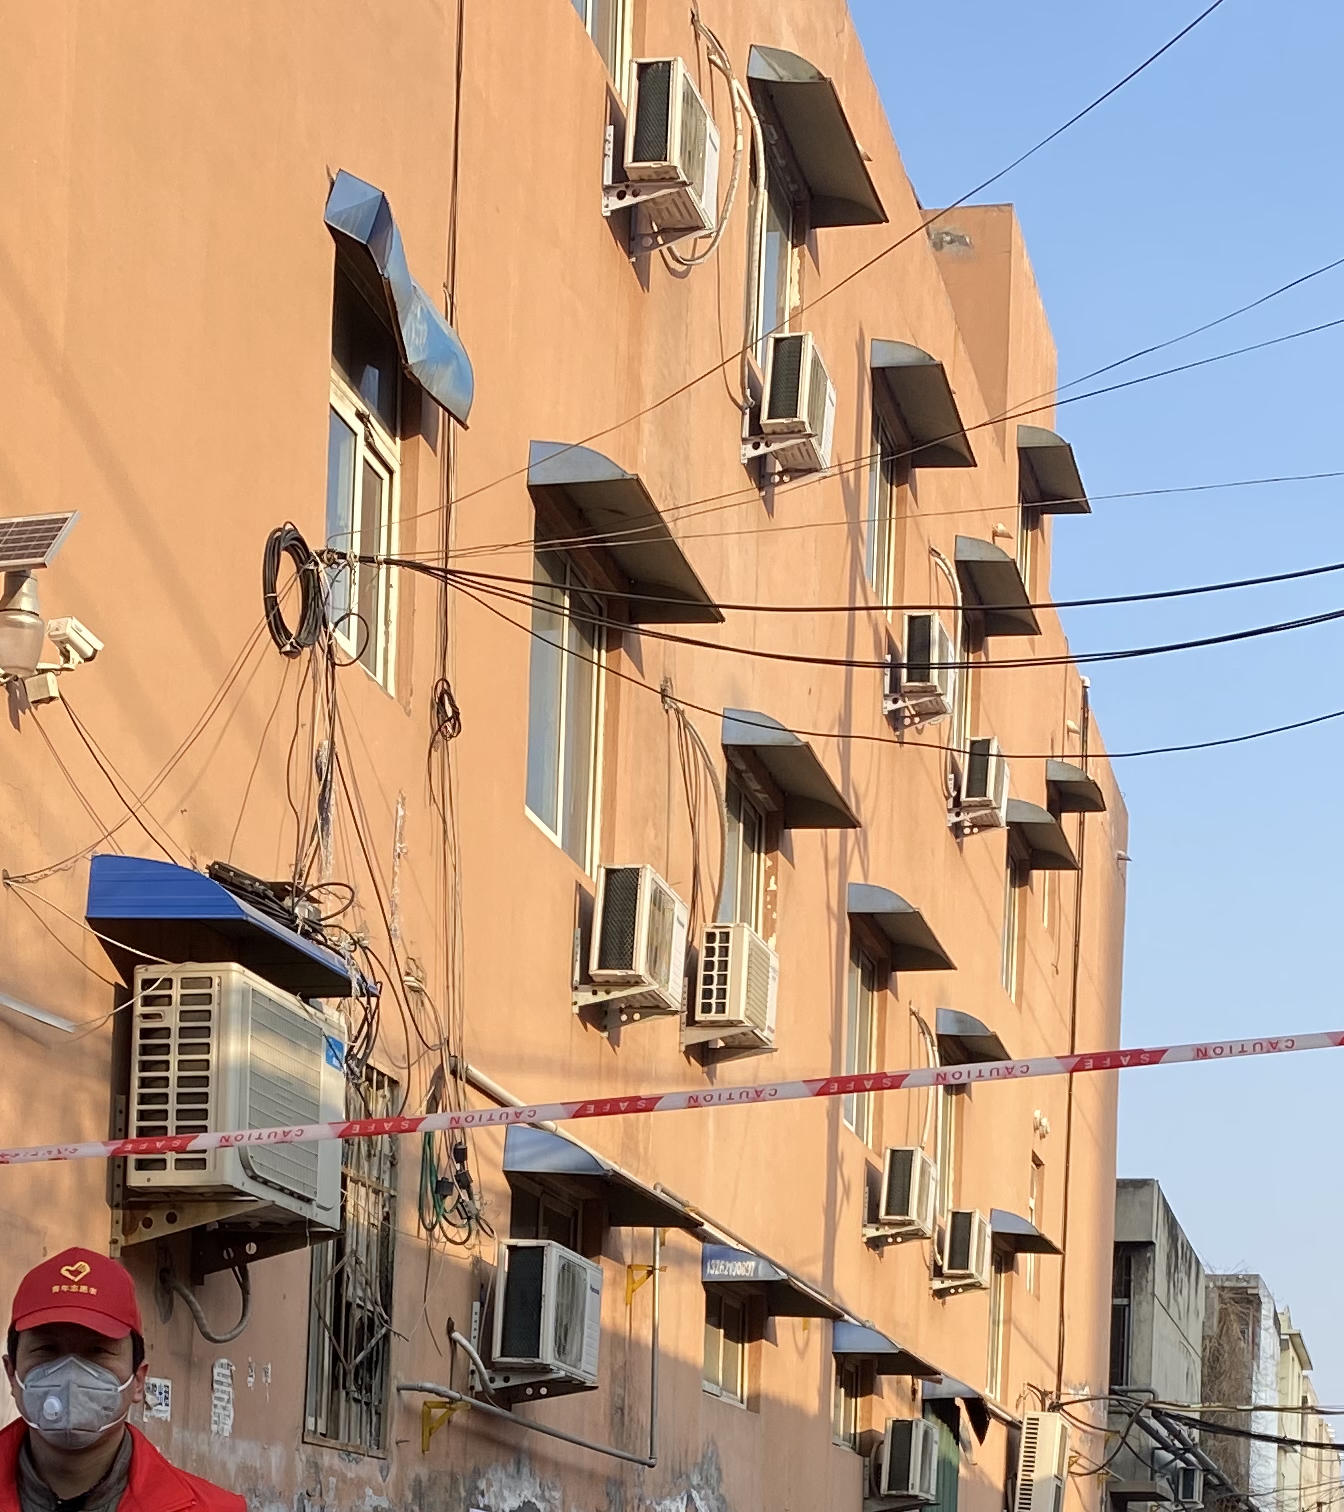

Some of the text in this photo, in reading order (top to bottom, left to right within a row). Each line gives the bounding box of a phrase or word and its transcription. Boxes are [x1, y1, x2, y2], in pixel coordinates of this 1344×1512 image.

[1195, 1037, 1296, 1059] CAUTION
[1084, 1052, 1152, 1070] SAFE
[934, 1063, 1031, 1083] CAUTION
[828, 1077, 893, 1093] SAFE
[686, 1087, 779, 1106] CAUTION
[585, 1098, 648, 1114] SAFE
[449, 1108, 537, 1127] CAUTION
[218, 1127, 306, 1145] CAUTION
[351, 1120, 410, 1134] SAFE
[123, 1138, 183, 1152] SAFE
